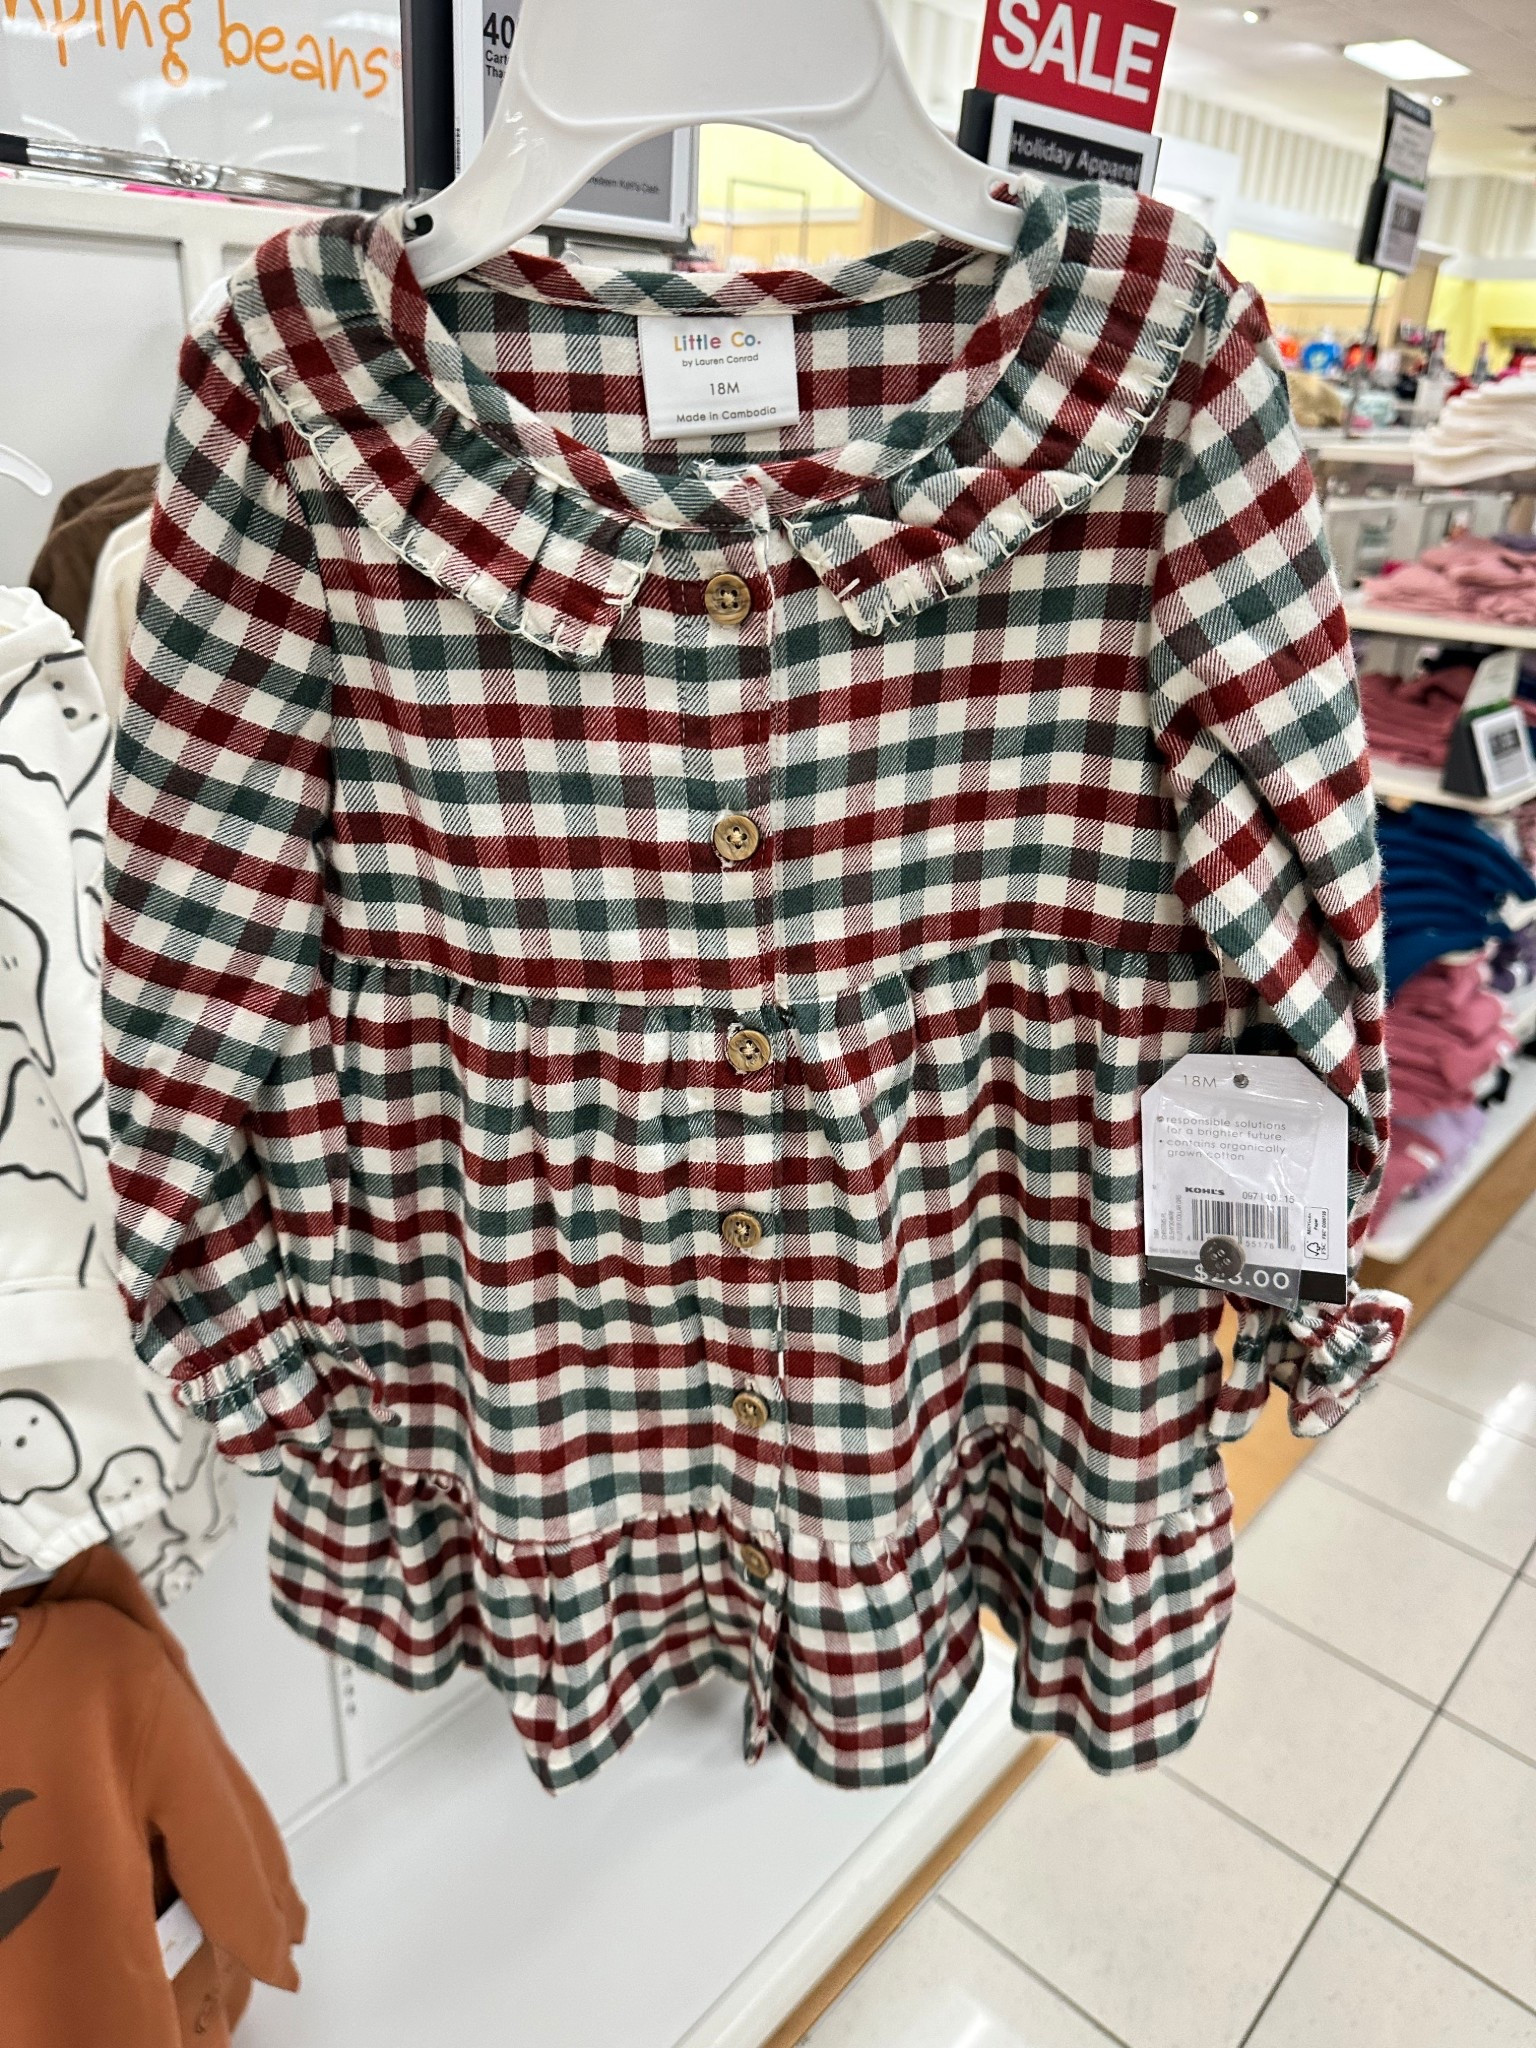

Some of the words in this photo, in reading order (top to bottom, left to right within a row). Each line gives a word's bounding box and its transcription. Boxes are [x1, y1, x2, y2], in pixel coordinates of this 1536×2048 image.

[483, 12, 516, 49] 40
[218, 0, 389, 98] beans
[992, 0, 1160, 104] SALE
[485, 49, 509, 66] Cart
[485, 65, 505, 79] Tha
[1009, 131, 1076, 172] Holiday
[1076, 147, 1141, 184] Apparel
[674, 334, 722, 352] Little
[731, 331, 762, 348] Co.
[682, 359, 693, 368] by
[695, 357, 725, 366] Lauren
[727, 353, 759, 364] Conrad
[710, 382, 740, 396] 18M
[676, 413, 707, 423] Made
[709, 411, 719, 421] in
[721, 406, 777, 420] Cambodia
[1183, 1074, 1217, 1088] 18M
[1166, 1116, 1231, 1127] responsible
[1235, 1119, 1287, 1131] solutions
[1185, 1127, 1193, 1135] a
[1197, 1127, 1243, 1139] brighter
[1166, 1139, 1216, 1149] contains
[1219, 1142, 1286, 1155] organically
[1167, 1150, 1203, 1158] grown
[1206, 1151, 1245, 1160] cotton
[1185, 1186, 1225, 1195] KOHL'S
